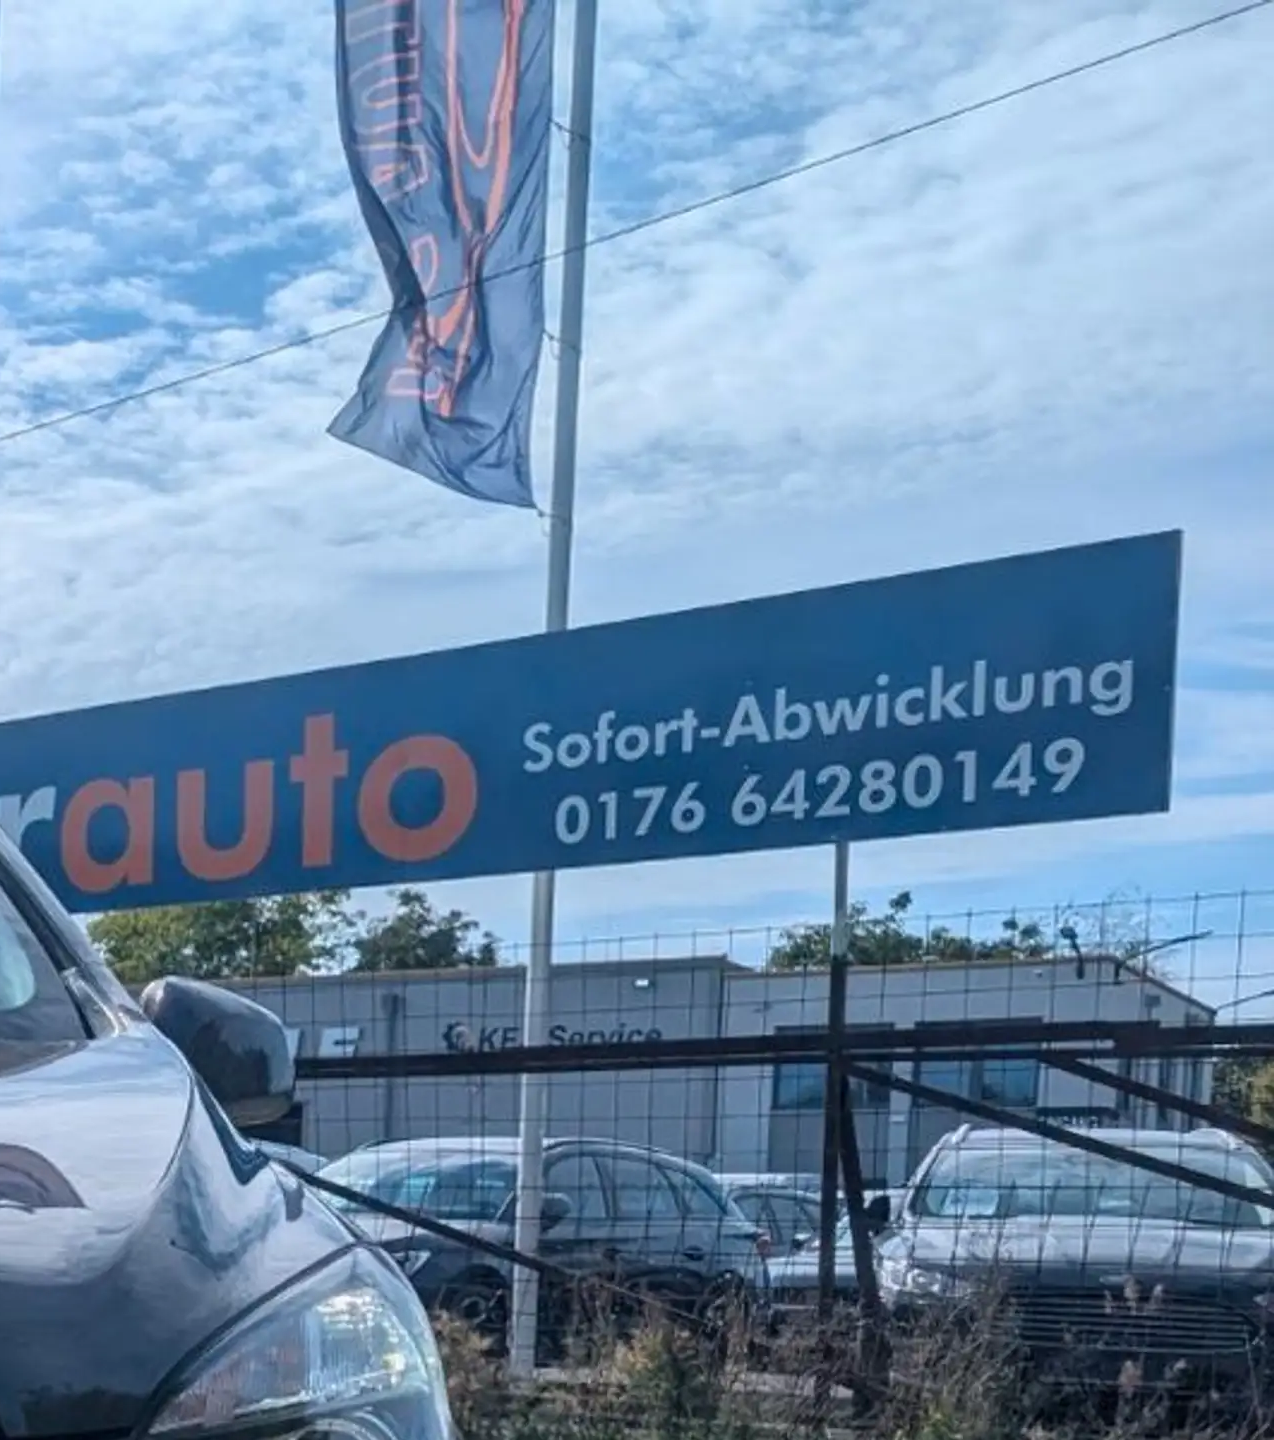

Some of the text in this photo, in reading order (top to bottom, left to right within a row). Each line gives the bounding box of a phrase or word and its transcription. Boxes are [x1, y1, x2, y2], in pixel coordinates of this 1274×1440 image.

[523, 659, 1134, 773] Sofort-Abwicklung
[555, 737, 1086, 844] 0176 64280149
